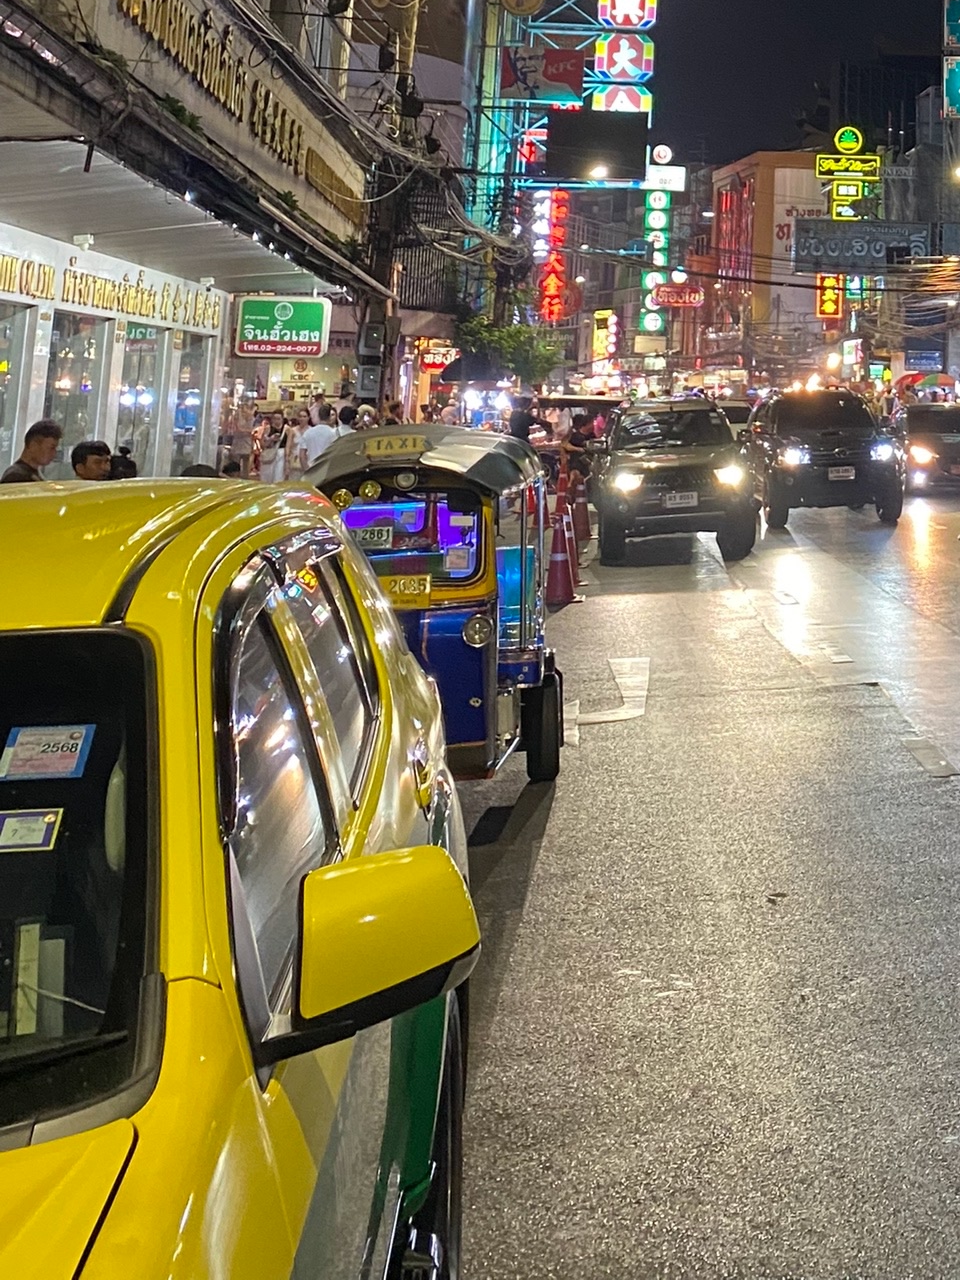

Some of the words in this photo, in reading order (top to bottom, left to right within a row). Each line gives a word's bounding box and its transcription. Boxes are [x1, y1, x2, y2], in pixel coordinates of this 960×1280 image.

[548, 60, 576, 76] KFC
[243, 320, 320, 342] จินฮั้วเฮง
[374, 437, 418, 450] TAXI
[361, 527, 391, 541] 2861
[40, 742, 79, 754] 2568
